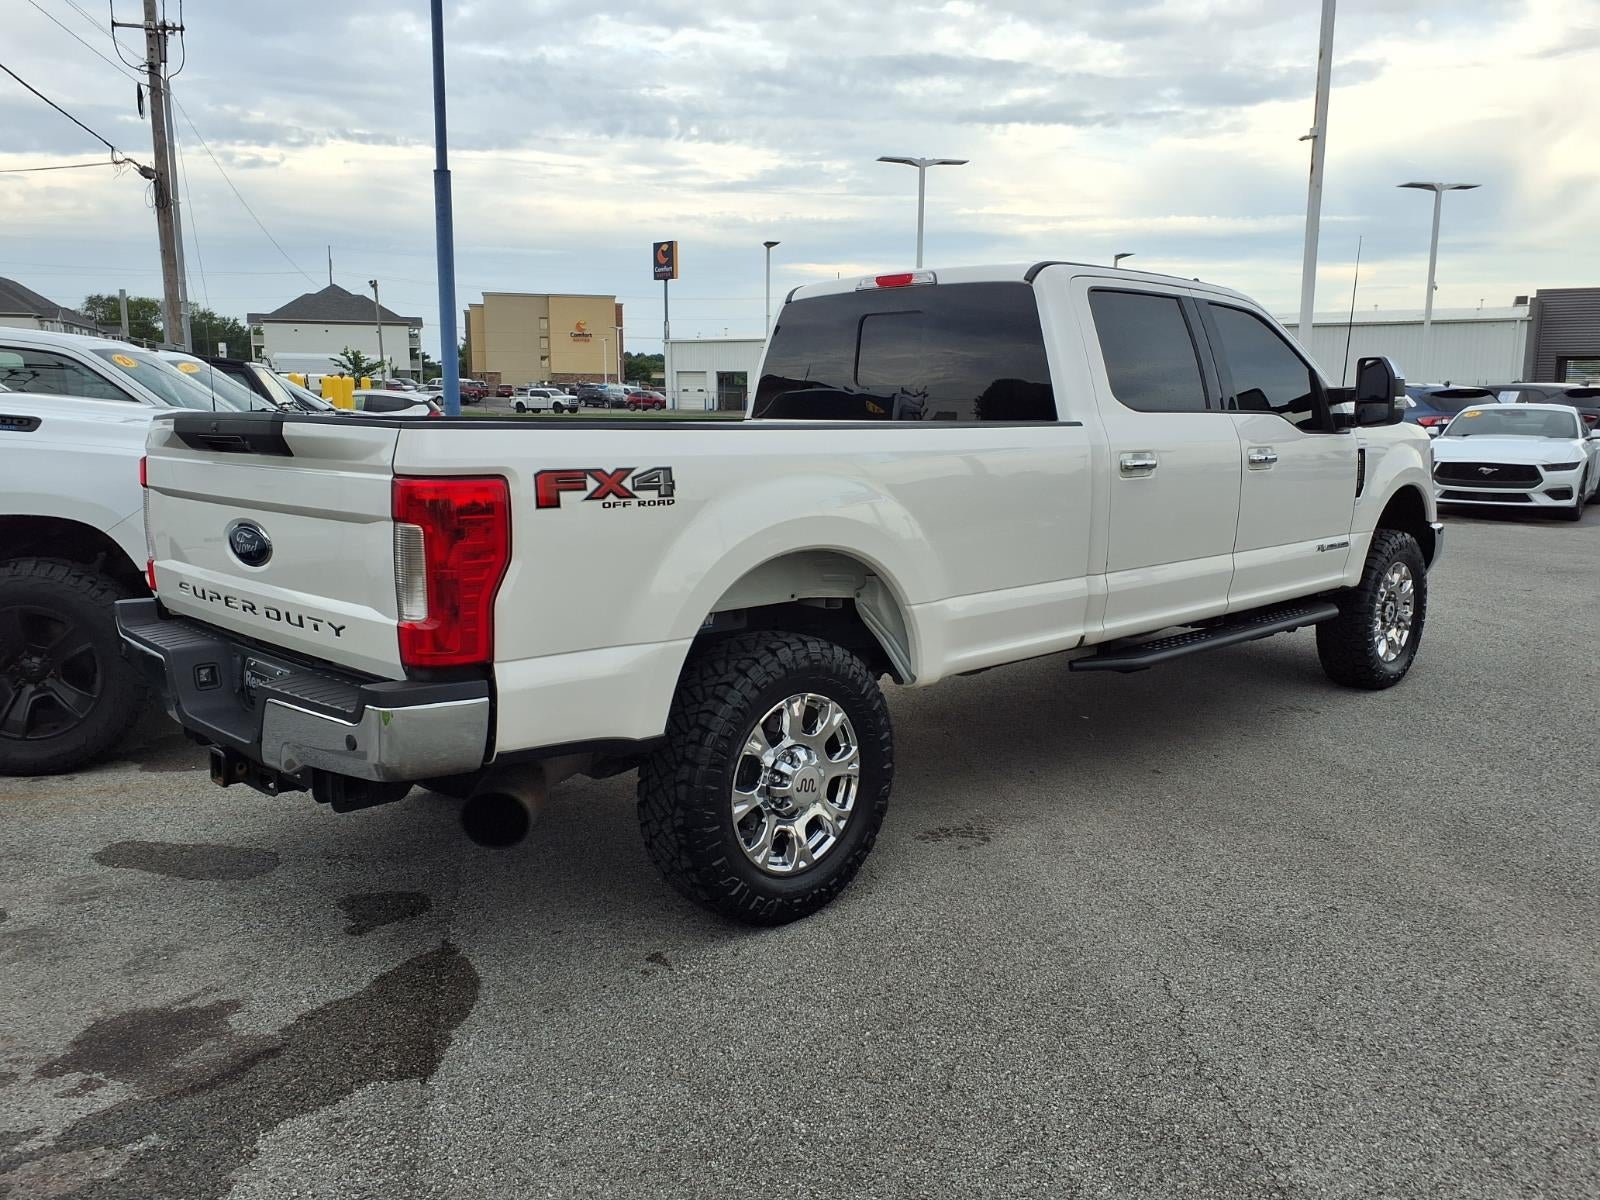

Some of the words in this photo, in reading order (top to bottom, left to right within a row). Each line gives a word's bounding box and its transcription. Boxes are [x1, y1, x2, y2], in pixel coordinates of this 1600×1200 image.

[655, 265, 673, 273] Comfort
[534, 466, 676, 510] FX4
[602, 500, 632, 509] OFF
[637, 498, 676, 508] ROAD
[234, 531, 259, 554] Ford
[178, 581, 260, 616] SUPER
[263, 605, 346, 638] DUTY
